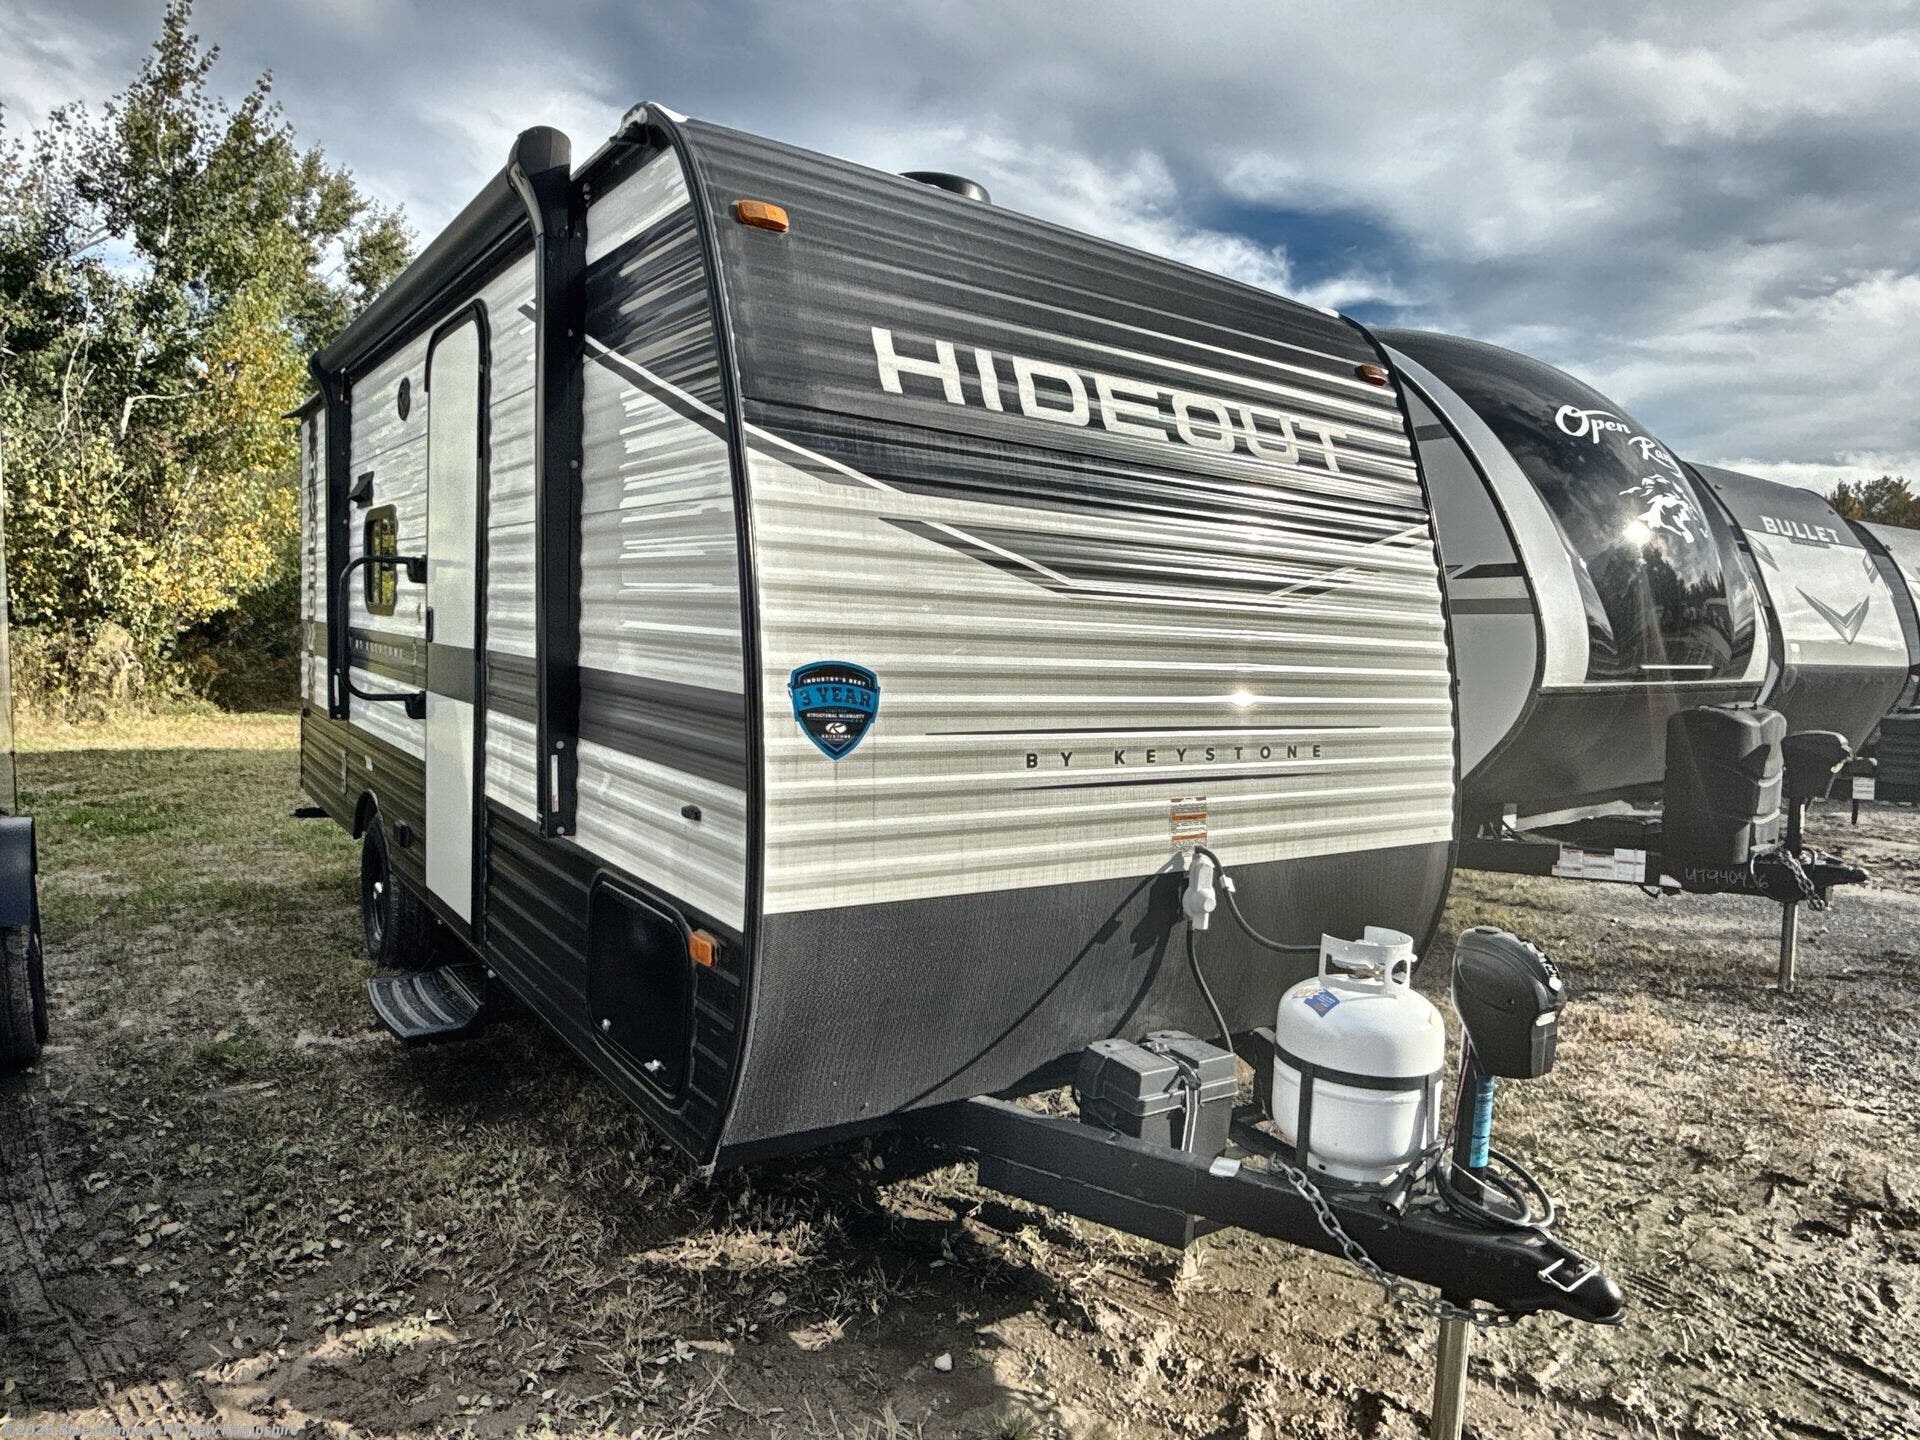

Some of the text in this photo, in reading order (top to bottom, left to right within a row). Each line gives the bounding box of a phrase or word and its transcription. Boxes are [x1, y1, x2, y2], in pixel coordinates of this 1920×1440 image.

[871, 326, 1351, 472] HIDEOUT
[1555, 404, 1631, 444] Open
[1760, 515, 1840, 543] BULLET
[848, 678, 866, 686] BEST
[800, 686, 871, 708] 3 YEAR
[1026, 744, 1321, 769] BY KEYSTONE
